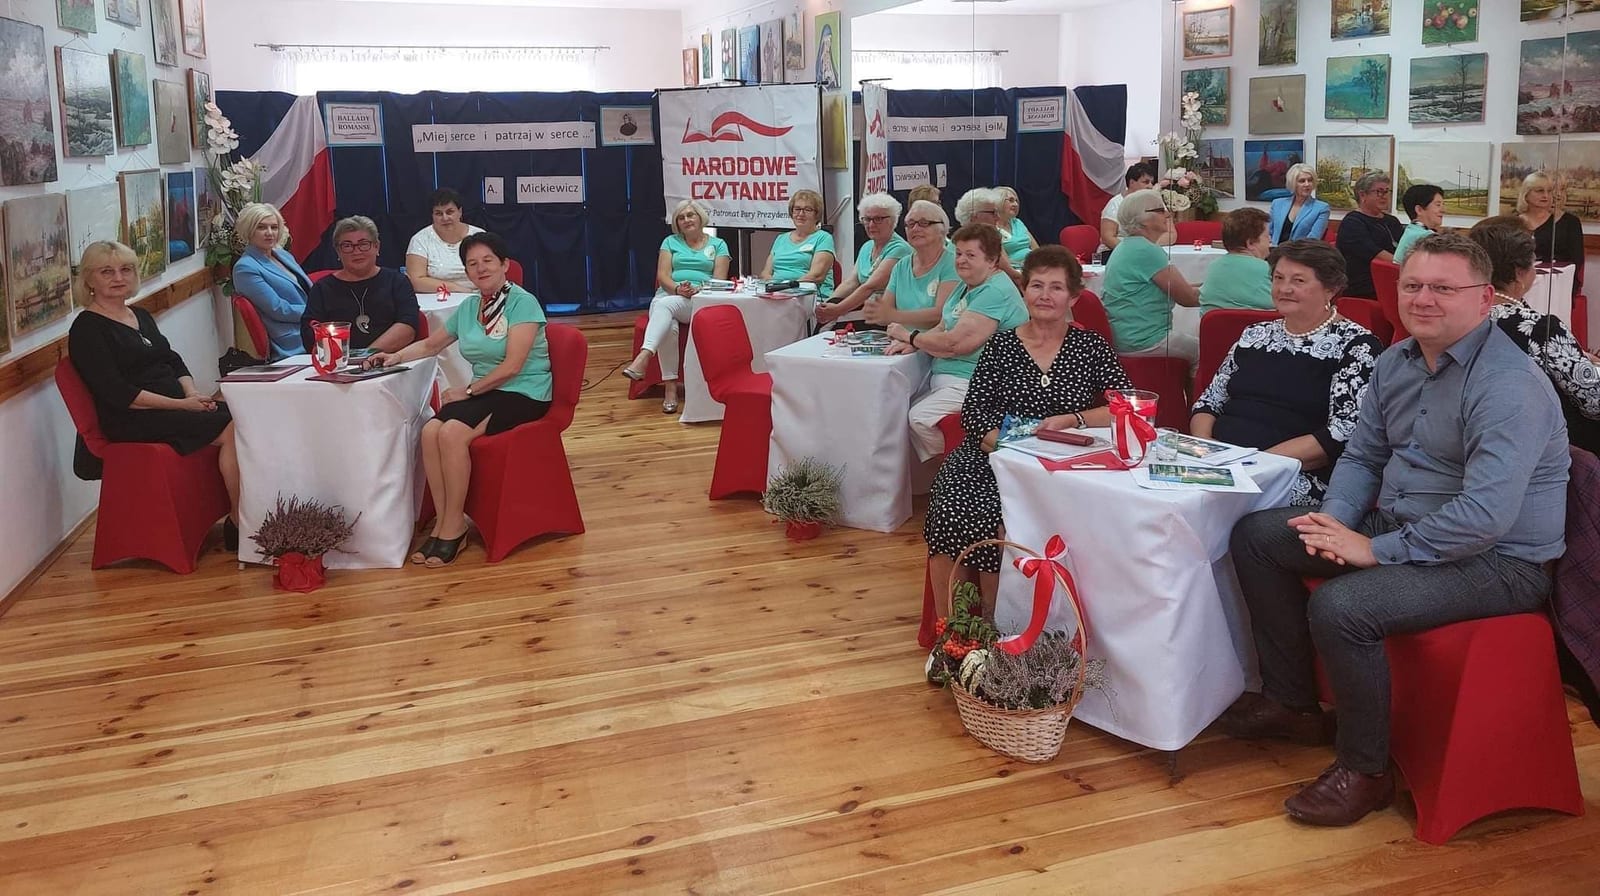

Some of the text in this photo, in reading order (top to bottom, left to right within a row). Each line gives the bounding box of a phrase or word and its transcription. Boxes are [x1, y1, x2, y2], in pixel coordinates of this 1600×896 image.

[450, 132, 476, 141] serce
[495, 129, 532, 142] patrzaj
[535, 131, 544, 139] w
[550, 130, 579, 139] serce
[681, 156, 798, 175] NARODOWE
[487, 184, 498, 194] A.
[520, 183, 579, 193] Mickiewicz
[691, 181, 790, 200] CZYTANIE
[712, 208, 739, 218] Patronat
